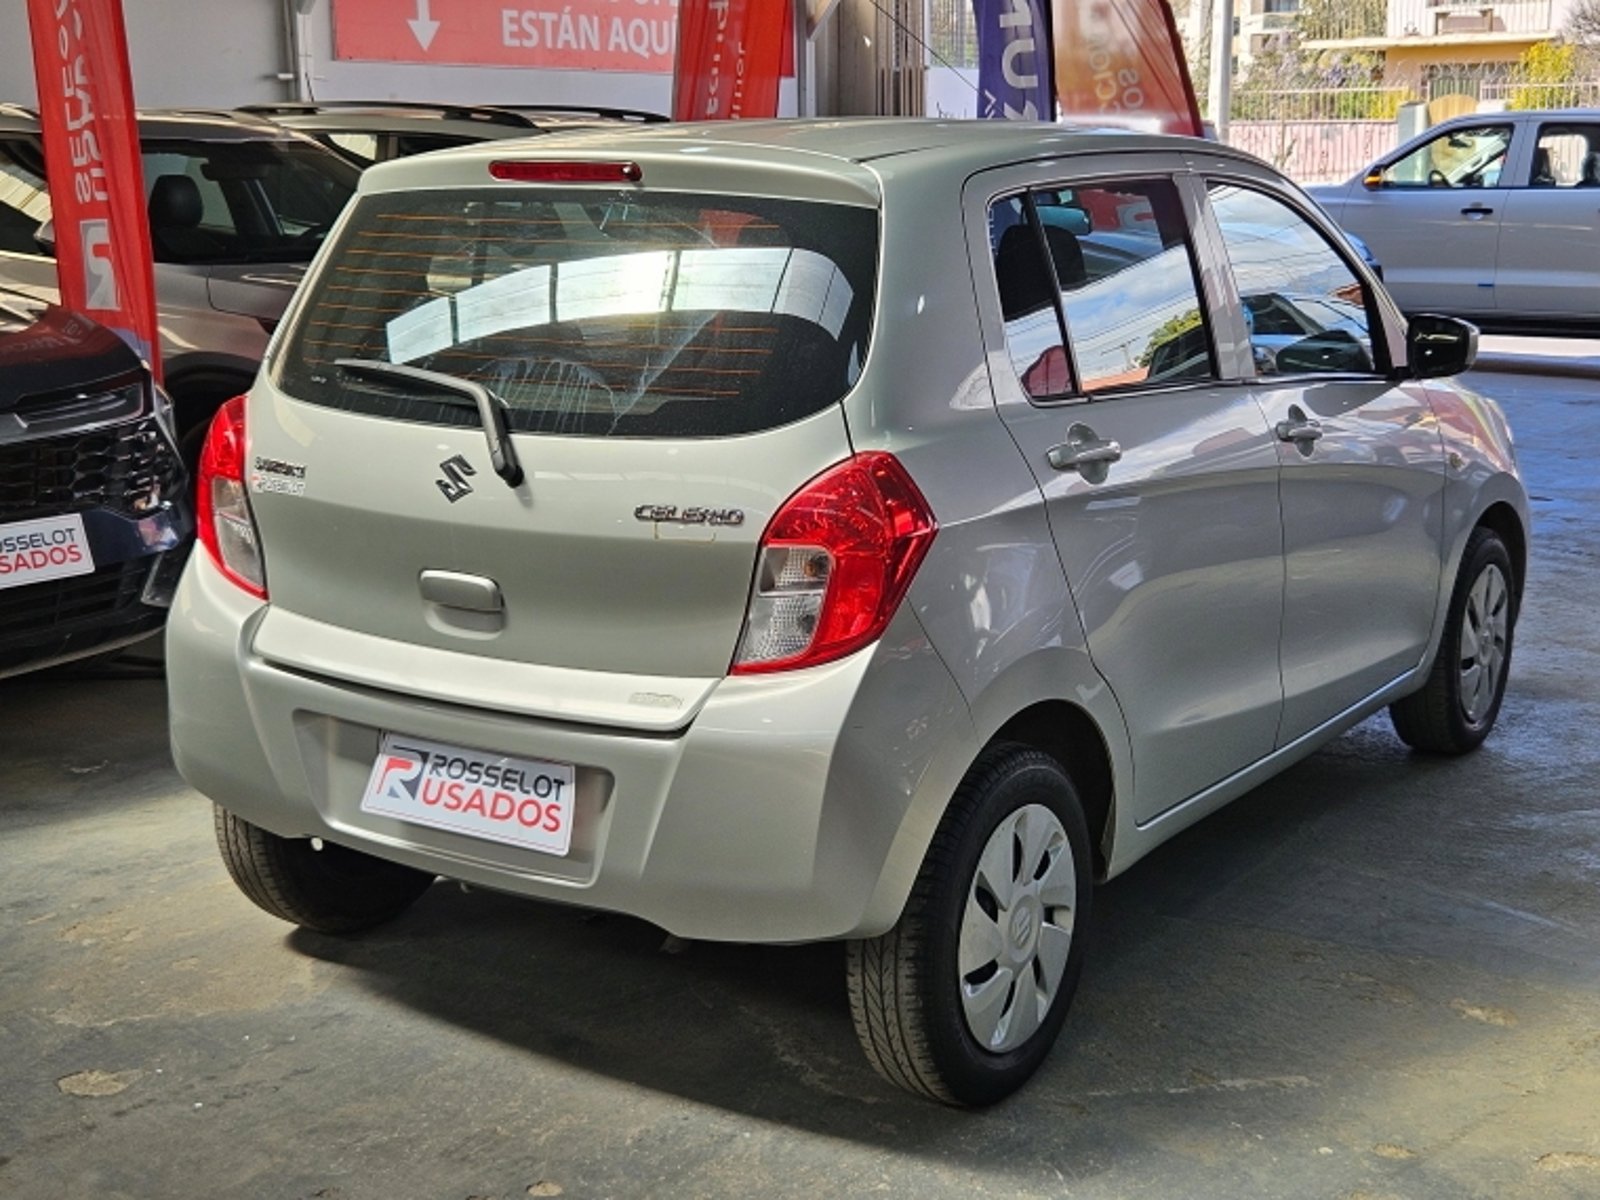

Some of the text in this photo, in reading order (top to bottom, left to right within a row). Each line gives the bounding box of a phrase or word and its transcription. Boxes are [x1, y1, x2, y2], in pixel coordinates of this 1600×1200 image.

[502, 6, 600, 51] ESTÁN
[0, 527, 77, 553] SSELOT
[429, 754, 565, 801] ROSSELOT
[422, 778, 562, 832] USADOS
